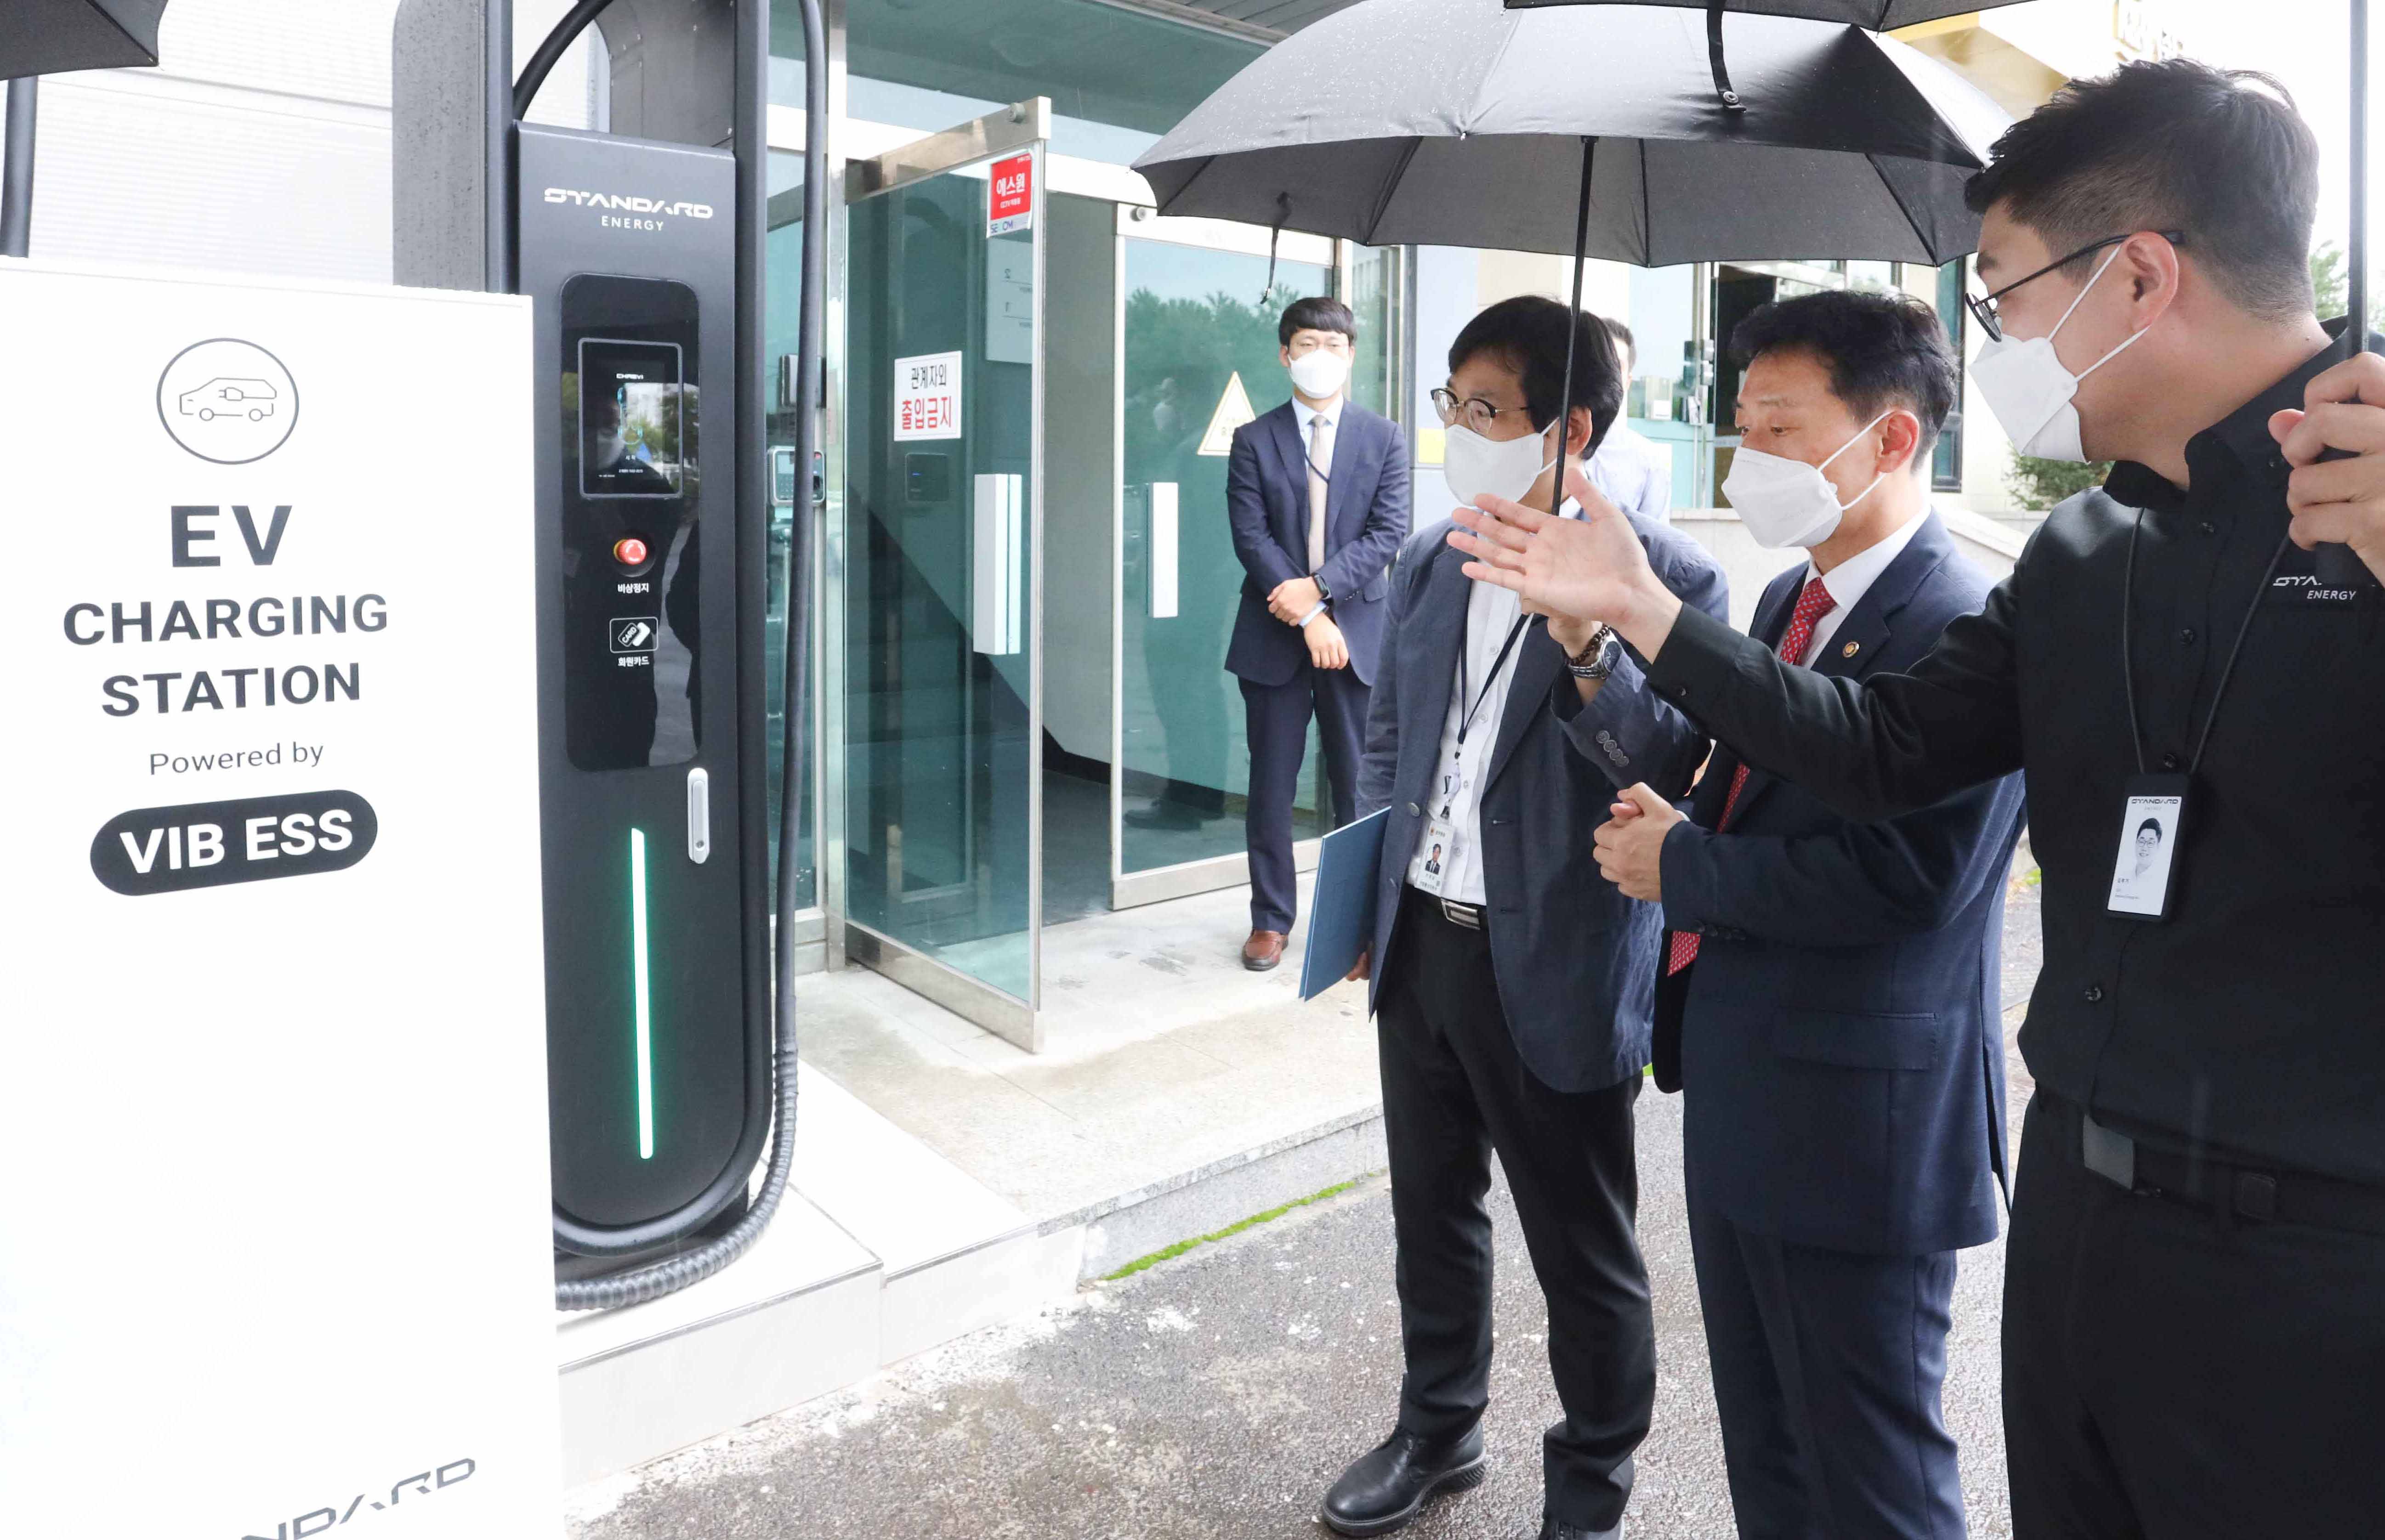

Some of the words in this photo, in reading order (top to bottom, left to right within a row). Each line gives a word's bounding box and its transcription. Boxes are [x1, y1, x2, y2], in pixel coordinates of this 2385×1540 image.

[996, 172, 1025, 197] 에스원
[545, 188, 713, 219] STANDARD
[602, 215, 664, 231] ENERGY
[911, 363, 947, 390] 관계자외
[902, 396, 952, 430] 출입금지
[171, 506, 292, 567] EV
[618, 583, 649, 594] 비상정지
[2307, 590, 2357, 600] ENERGY
[64, 594, 387, 645] CHARGING
[622, 627, 637, 643] CARD
[618, 656, 649, 667] 회원카드
[102, 663, 359, 716] STATION
[151, 743, 281, 775] Powered
[293, 742, 324, 767] by
[119, 822, 225, 874] VIB
[246, 810, 353, 861] ESS
